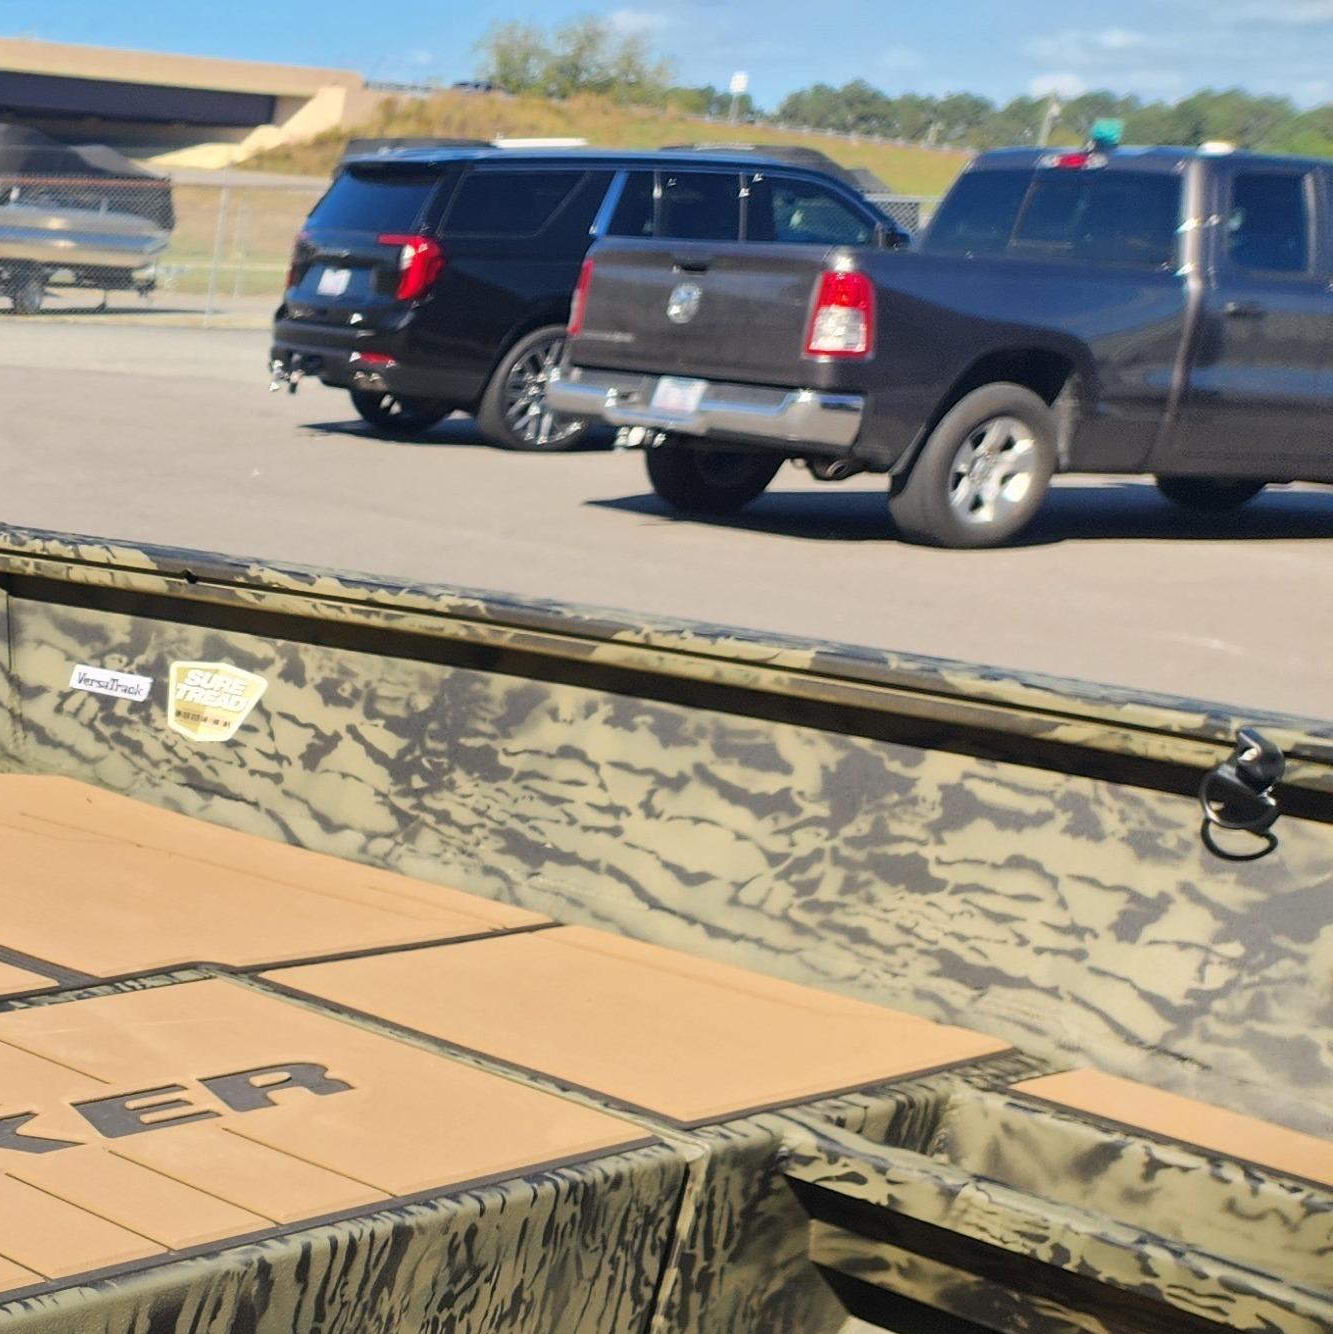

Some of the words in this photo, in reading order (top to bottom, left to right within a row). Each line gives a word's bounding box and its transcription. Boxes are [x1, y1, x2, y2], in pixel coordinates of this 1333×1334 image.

[77, 672, 144, 696] VersaTrack
[184, 669, 247, 696] SURE
[175, 685, 247, 712] TREAD
